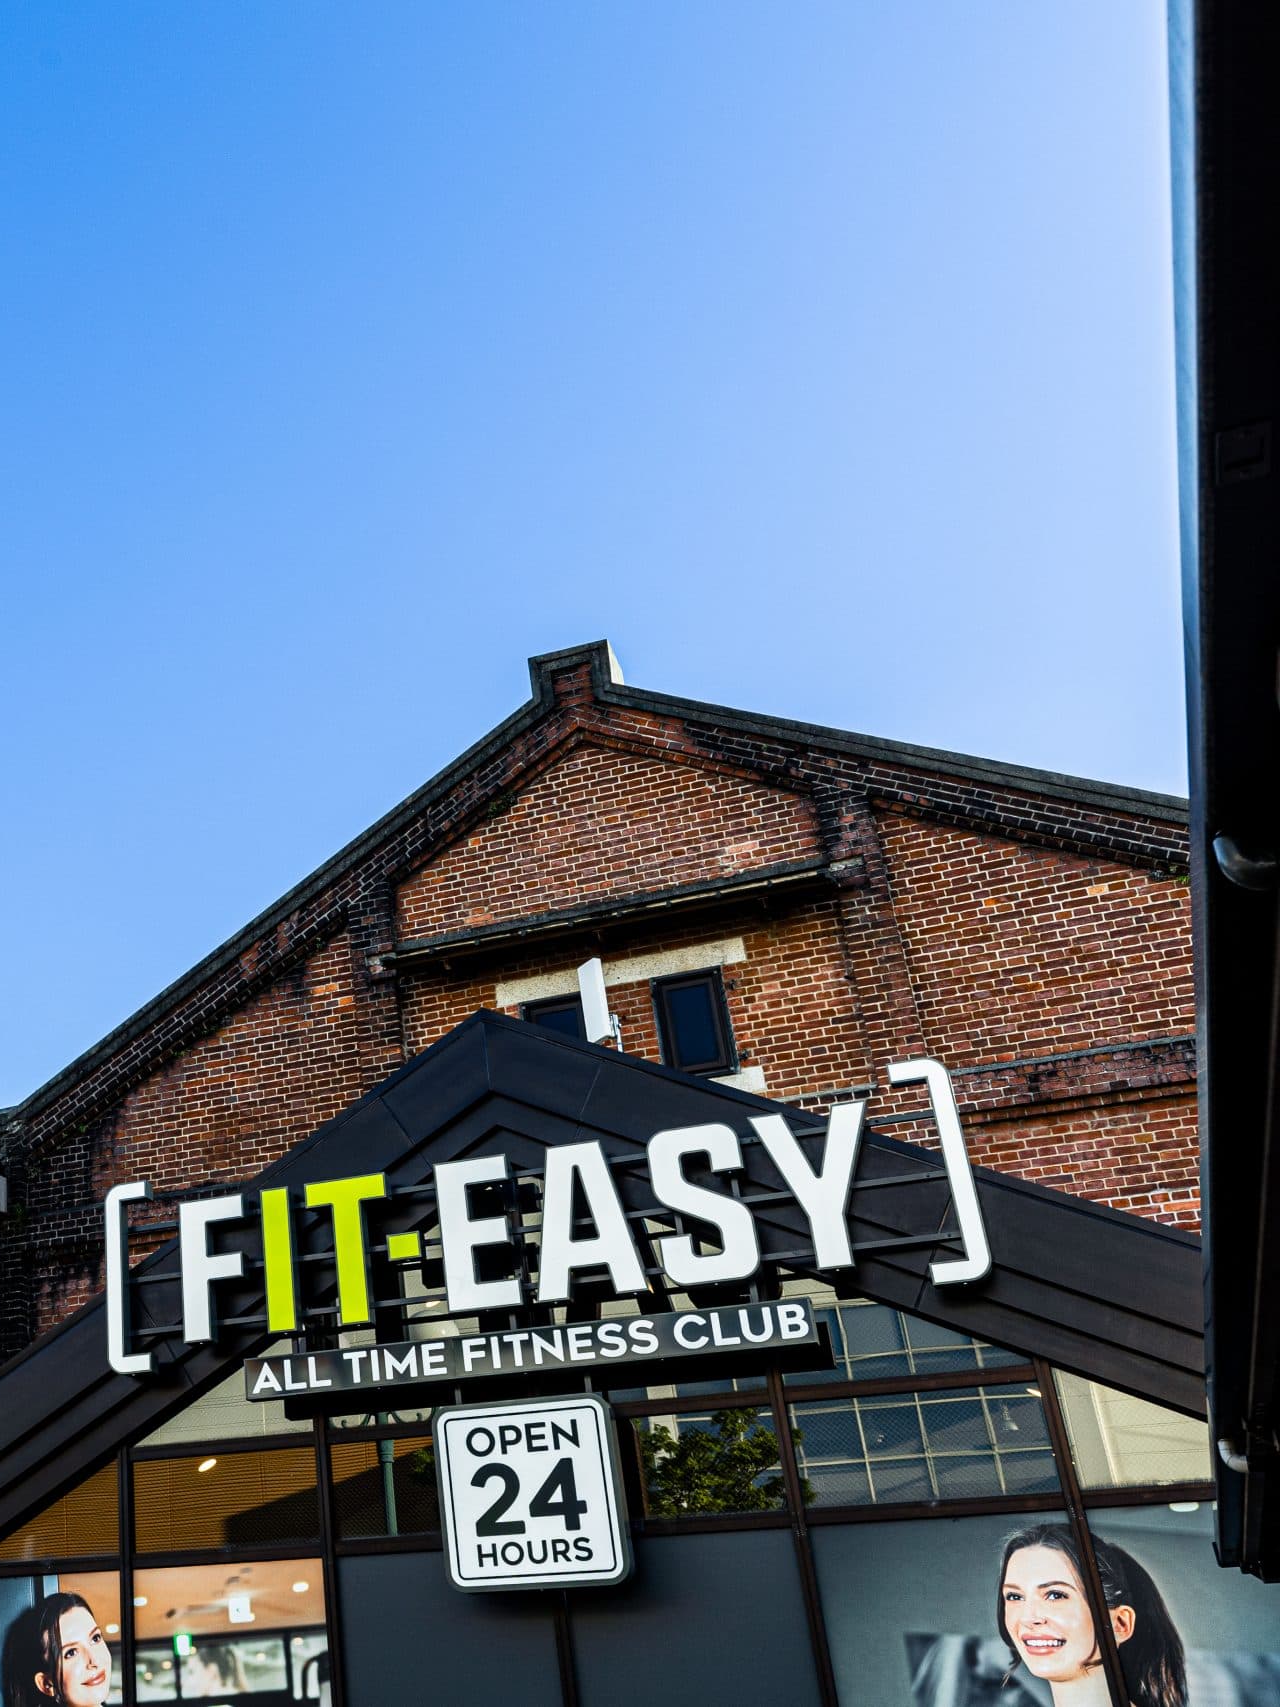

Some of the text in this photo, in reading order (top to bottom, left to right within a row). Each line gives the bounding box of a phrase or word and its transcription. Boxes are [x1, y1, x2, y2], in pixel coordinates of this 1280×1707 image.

[252, 1303, 810, 1394] ALL TIME FITNESS CLUB
[466, 1418, 581, 1457] OPEN
[470, 1457, 588, 1537] 24
[476, 1536, 594, 1568] HOURS
